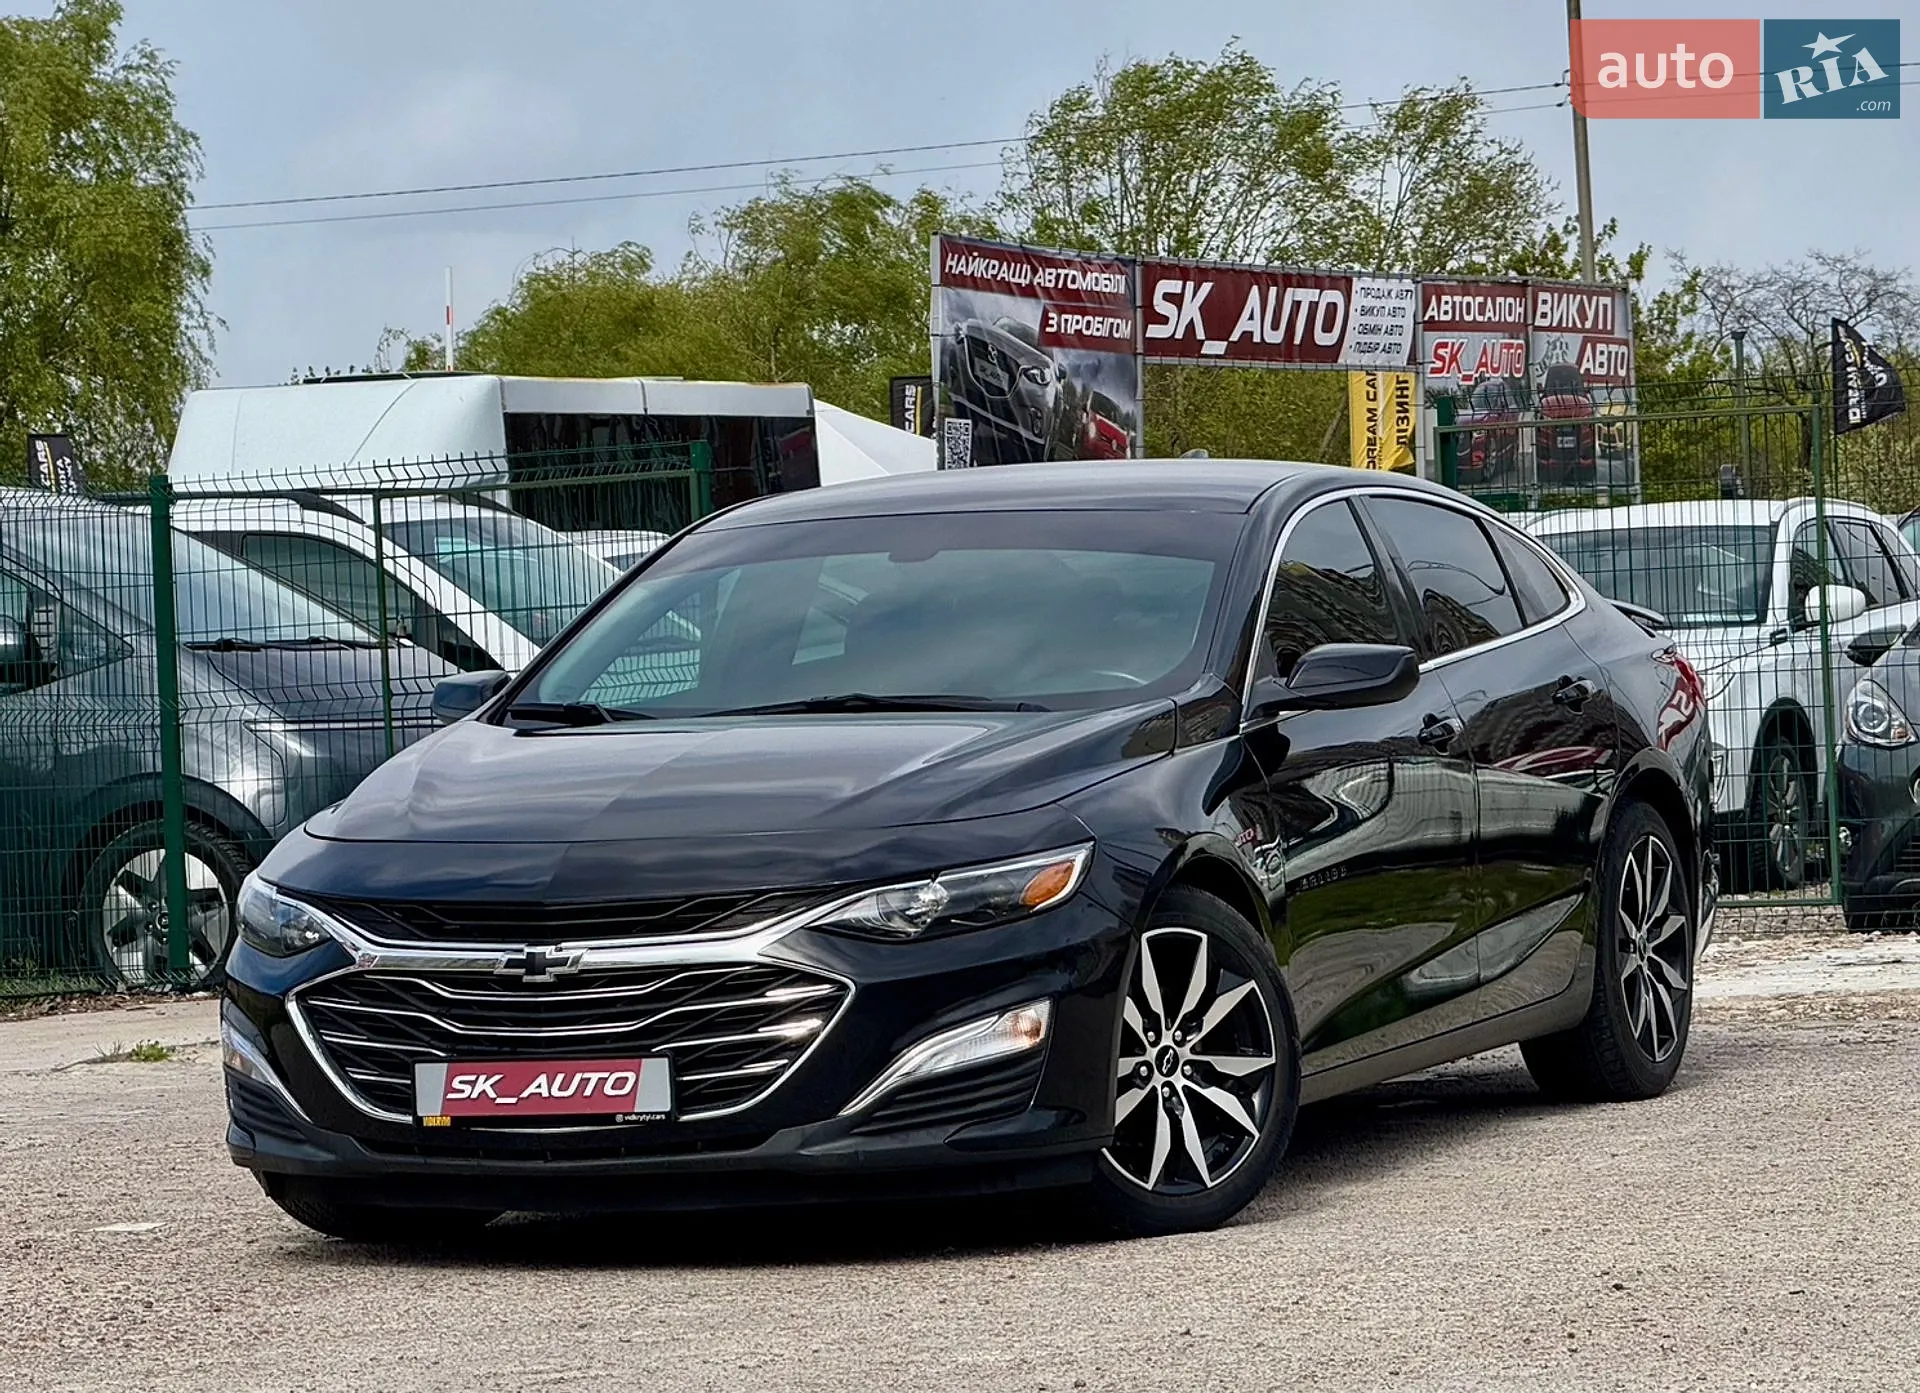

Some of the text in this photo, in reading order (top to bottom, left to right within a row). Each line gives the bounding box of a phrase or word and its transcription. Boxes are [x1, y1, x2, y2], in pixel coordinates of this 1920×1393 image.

[945, 252, 1127, 295] НАЙКРАЩІ АВТОМОБІЛІ
[1145, 279, 1345, 355] SK_AUTO
[1360, 305, 1406, 318] ВИКУП АВТО
[1424, 295, 1526, 323] АВТОСАЛОН
[1534, 291, 1612, 330] ВИКУП
[1060, 314, 1132, 340] ПРОБІГОМ
[1358, 323, 1404, 336] ОБМІН АВТО
[1380, 342, 1402, 354] АВТО
[1428, 338, 1526, 384] SK_AUTO
[1580, 342, 1628, 377] АВТО
[446, 1071, 637, 1104] SK_AUTO
